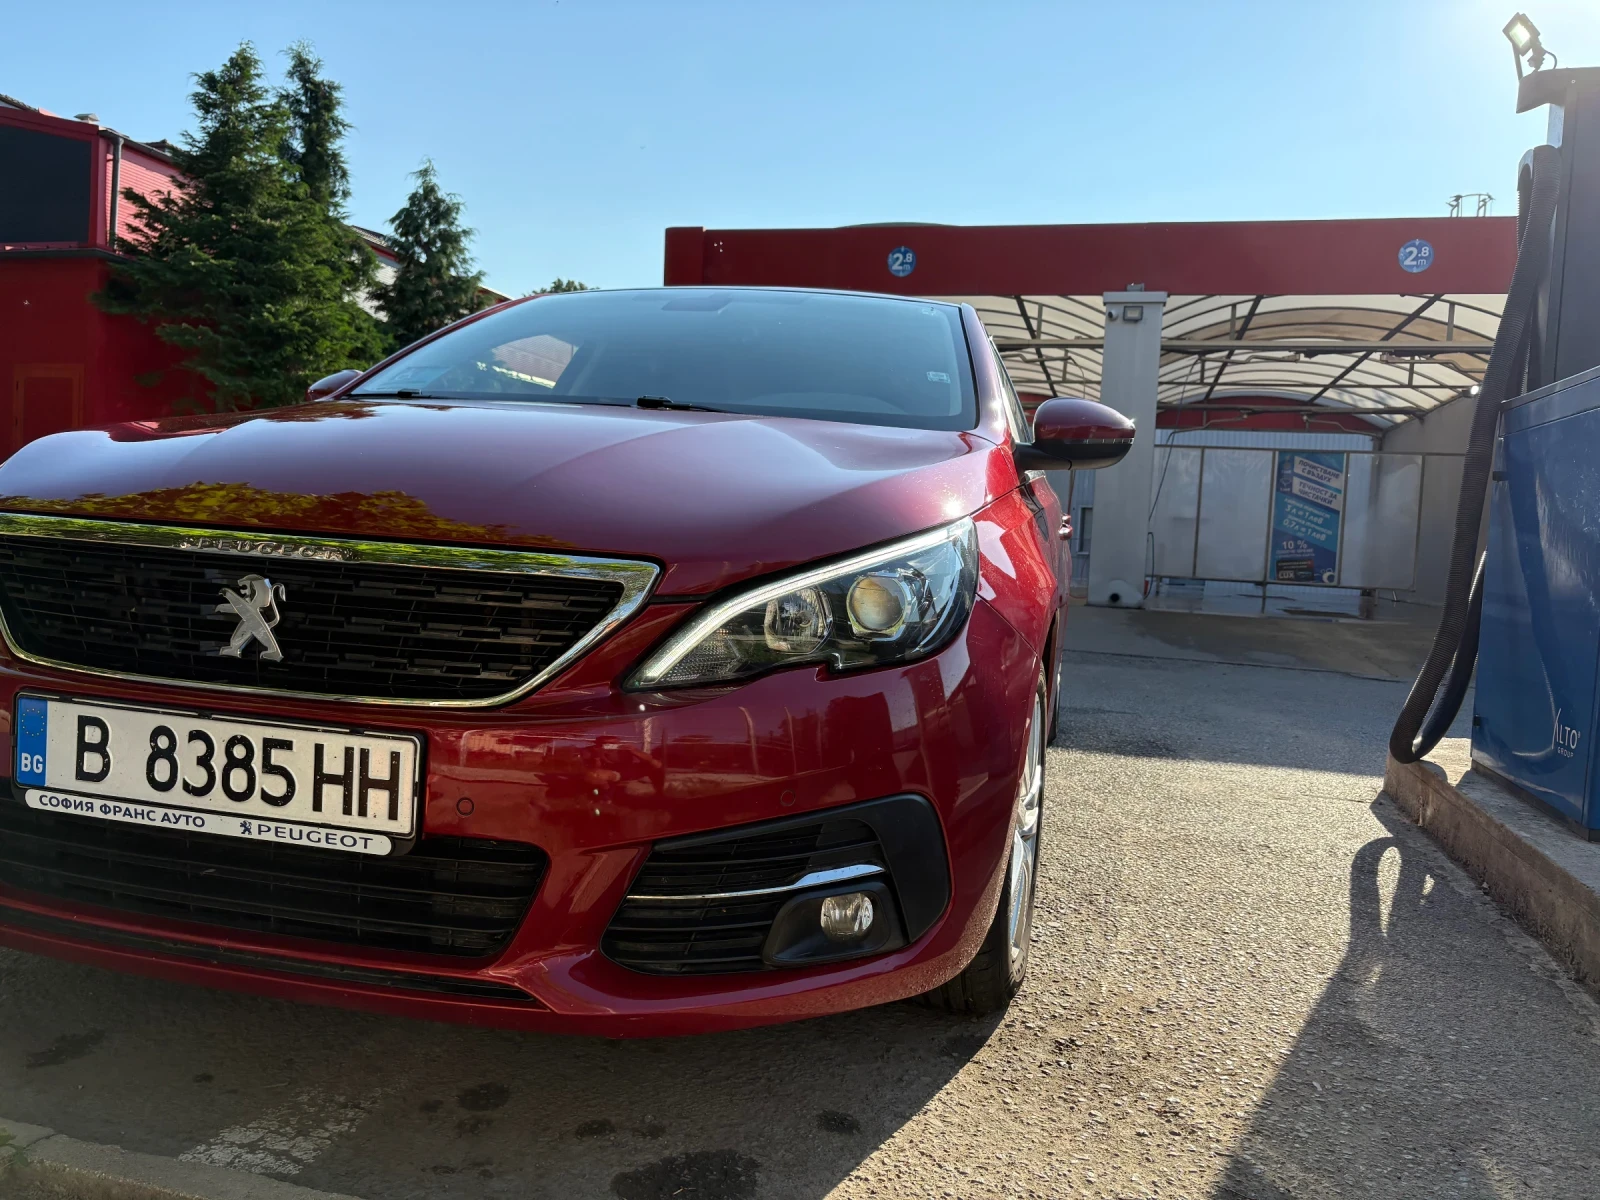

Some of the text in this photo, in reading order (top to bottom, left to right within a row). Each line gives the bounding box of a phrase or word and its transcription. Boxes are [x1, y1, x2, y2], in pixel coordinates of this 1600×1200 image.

[892, 253, 913, 270] 2.8
[1403, 246, 1429, 266] 2.8
[1299, 460, 1340, 479] ПОЧИСТВАНЕ
[1307, 469, 1332, 483] ВЪЗДУХ
[1298, 488, 1333, 505] ЧИСТАЧКИ
[1299, 481, 1328, 496] ТЕЧНОСТ
[197, 536, 340, 560] PEUGEOT
[20, 752, 44, 775] BG
[75, 714, 401, 821] B 8385 HH
[38, 793, 206, 829] СОФИЯ ФРАНС АУТО
[257, 823, 374, 851] PEUGEOT
